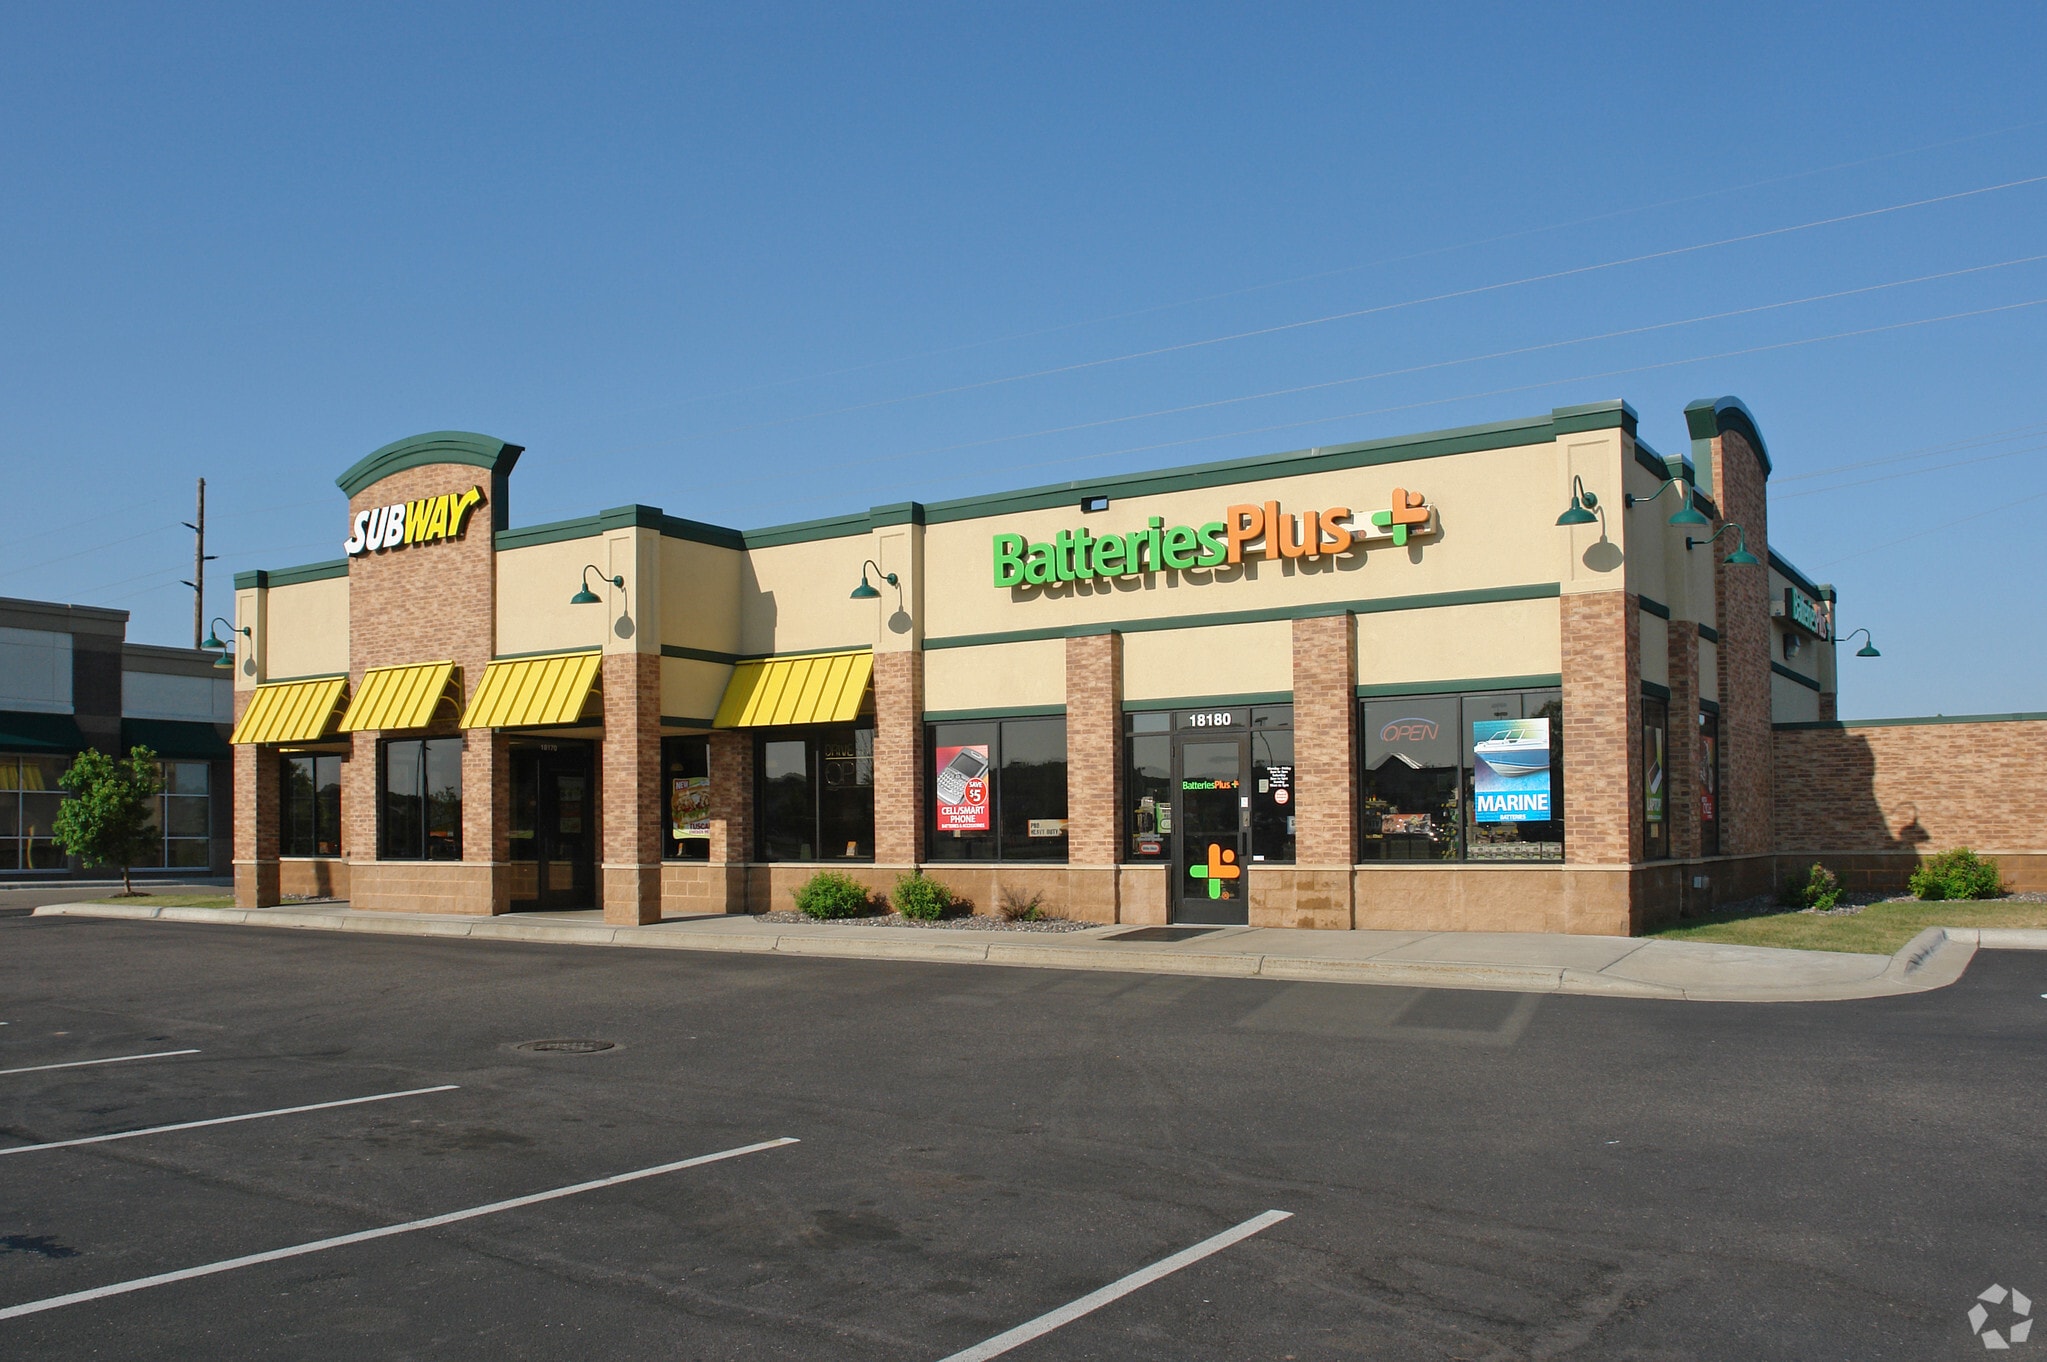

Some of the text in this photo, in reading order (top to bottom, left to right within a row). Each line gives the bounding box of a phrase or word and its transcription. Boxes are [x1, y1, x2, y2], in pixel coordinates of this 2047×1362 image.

[344, 485, 481, 556] SUBWAY
[993, 500, 1352, 588] BatteriesPlus
[1189, 713, 1231, 727] 18180
[1382, 724, 1439, 742] OPEN
[824, 744, 854, 757] DRIVE
[824, 762, 858, 786] OP
[675, 781, 689, 790] NEW
[1182, 780, 1232, 790] BatteriesPlus
[969, 789, 981, 802] $5
[1477, 794, 1549, 812] MARINE
[941, 806, 985, 815] CELL/SMART
[950, 815, 976, 823] PHONE
